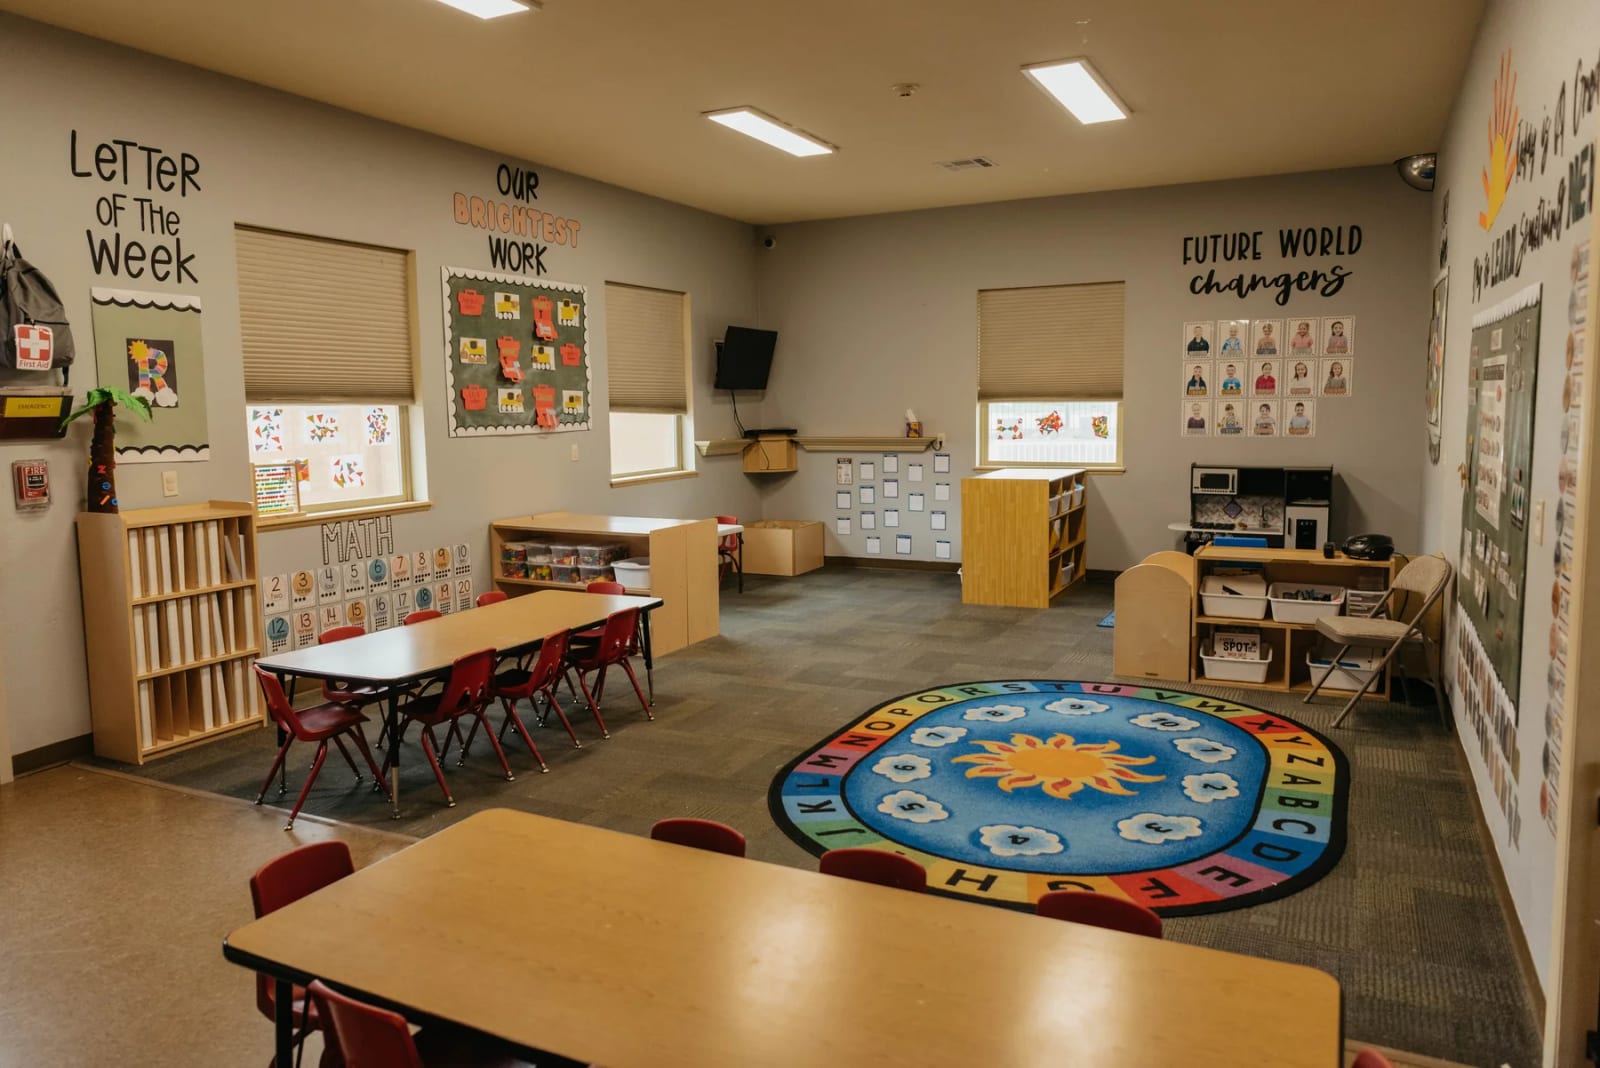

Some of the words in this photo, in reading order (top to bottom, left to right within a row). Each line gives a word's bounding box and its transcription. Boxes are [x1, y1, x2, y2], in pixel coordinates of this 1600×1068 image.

[1554, 80, 1566, 157] A
[496, 163, 540, 203] OUR
[96, 193, 126, 227] OF
[453, 192, 581, 248] BRIGHTEST
[1183, 231, 1263, 265] FUTURE
[1279, 224, 1363, 258] WORLD
[86, 229, 199, 284] Week
[488, 235, 548, 276] WORK
[1189, 265, 1353, 306] changers
[19, 360, 35, 368] First
[37, 361, 49, 369] Aid
[25, 466, 46, 475] FIRE
[320, 515, 394, 565] MATH
[438, 548, 445, 560] 9
[457, 545, 467, 558] 10
[396, 555, 403, 569] 7
[419, 552, 426, 566] 8
[350, 564, 358, 578] 5
[374, 559, 381, 574] 6
[298, 572, 308, 587] 3
[325, 568, 333, 581] 4
[271, 576, 280, 591] 2
[440, 583, 449, 597] 19
[458, 579, 470, 593] 20
[398, 592, 407, 607] 17
[420, 588, 429, 602] 18
[351, 601, 362, 616] 15
[375, 597, 386, 611] 16
[300, 612, 311, 628] 13
[326, 608, 336, 622] 14
[271, 617, 285, 634] 12
[1223, 641, 1249, 653] SPOT
[958, 687, 991, 695] R
[1002, 683, 1026, 691] S
[1045, 683, 1070, 691] T
[1092, 685, 1121, 693] U
[916, 694, 954, 703] Q
[1155, 691, 1181, 700] V
[887, 707, 914, 717] P
[1196, 701, 1243, 712] W
[864, 720, 896, 731] O
[1151, 717, 1180, 728] 10
[1245, 719, 1287, 731] X
[840, 735, 877, 747] N
[1273, 735, 1313, 746] Y
[807, 753, 848, 769] M
[1286, 753, 1324, 767] Z
[796, 778, 829, 787] L
[1281, 772, 1322, 786] A
[1202, 782, 1228, 791] 2
[797, 800, 836, 814] K
[898, 802, 925, 812] 5
[1277, 795, 1319, 809] B
[815, 828, 867, 836] J
[1145, 822, 1173, 833] 3
[1272, 818, 1316, 835] C
[1007, 834, 1030, 845] 4
[1252, 841, 1302, 862] D
[944, 868, 999, 892] H
[1197, 865, 1254, 888] E
[1140, 877, 1181, 899] F
